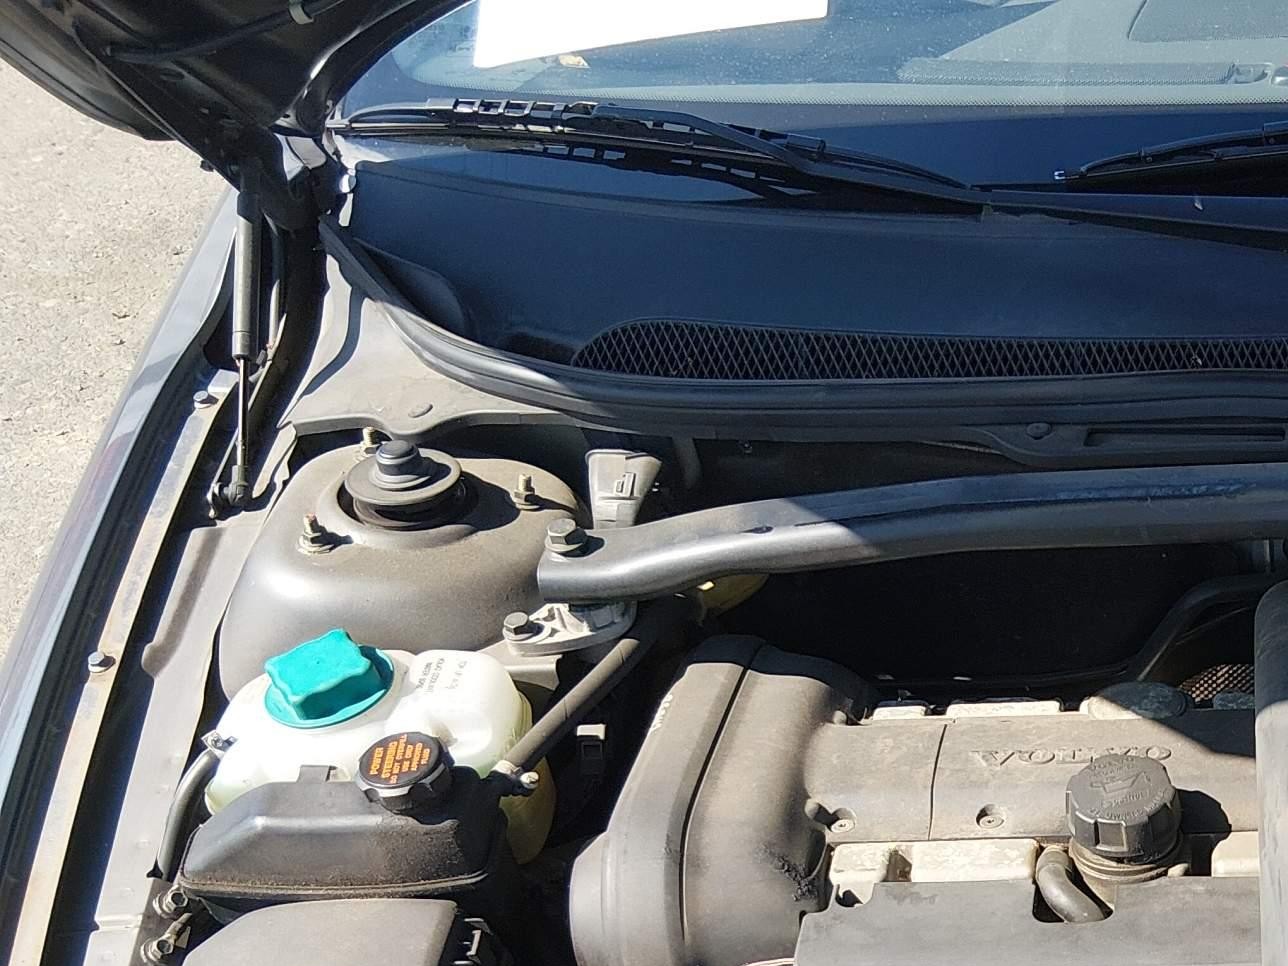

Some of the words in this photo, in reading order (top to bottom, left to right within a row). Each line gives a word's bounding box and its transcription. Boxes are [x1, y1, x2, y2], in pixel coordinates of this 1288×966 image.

[369, 747, 384, 775] POWER
[381, 741, 398, 779] STEERING
[392, 762, 401, 774] NOT
[401, 761, 410, 773] USE
[410, 742, 423, 771] APPROVED
[970, 746, 1172, 766] VOLVO
